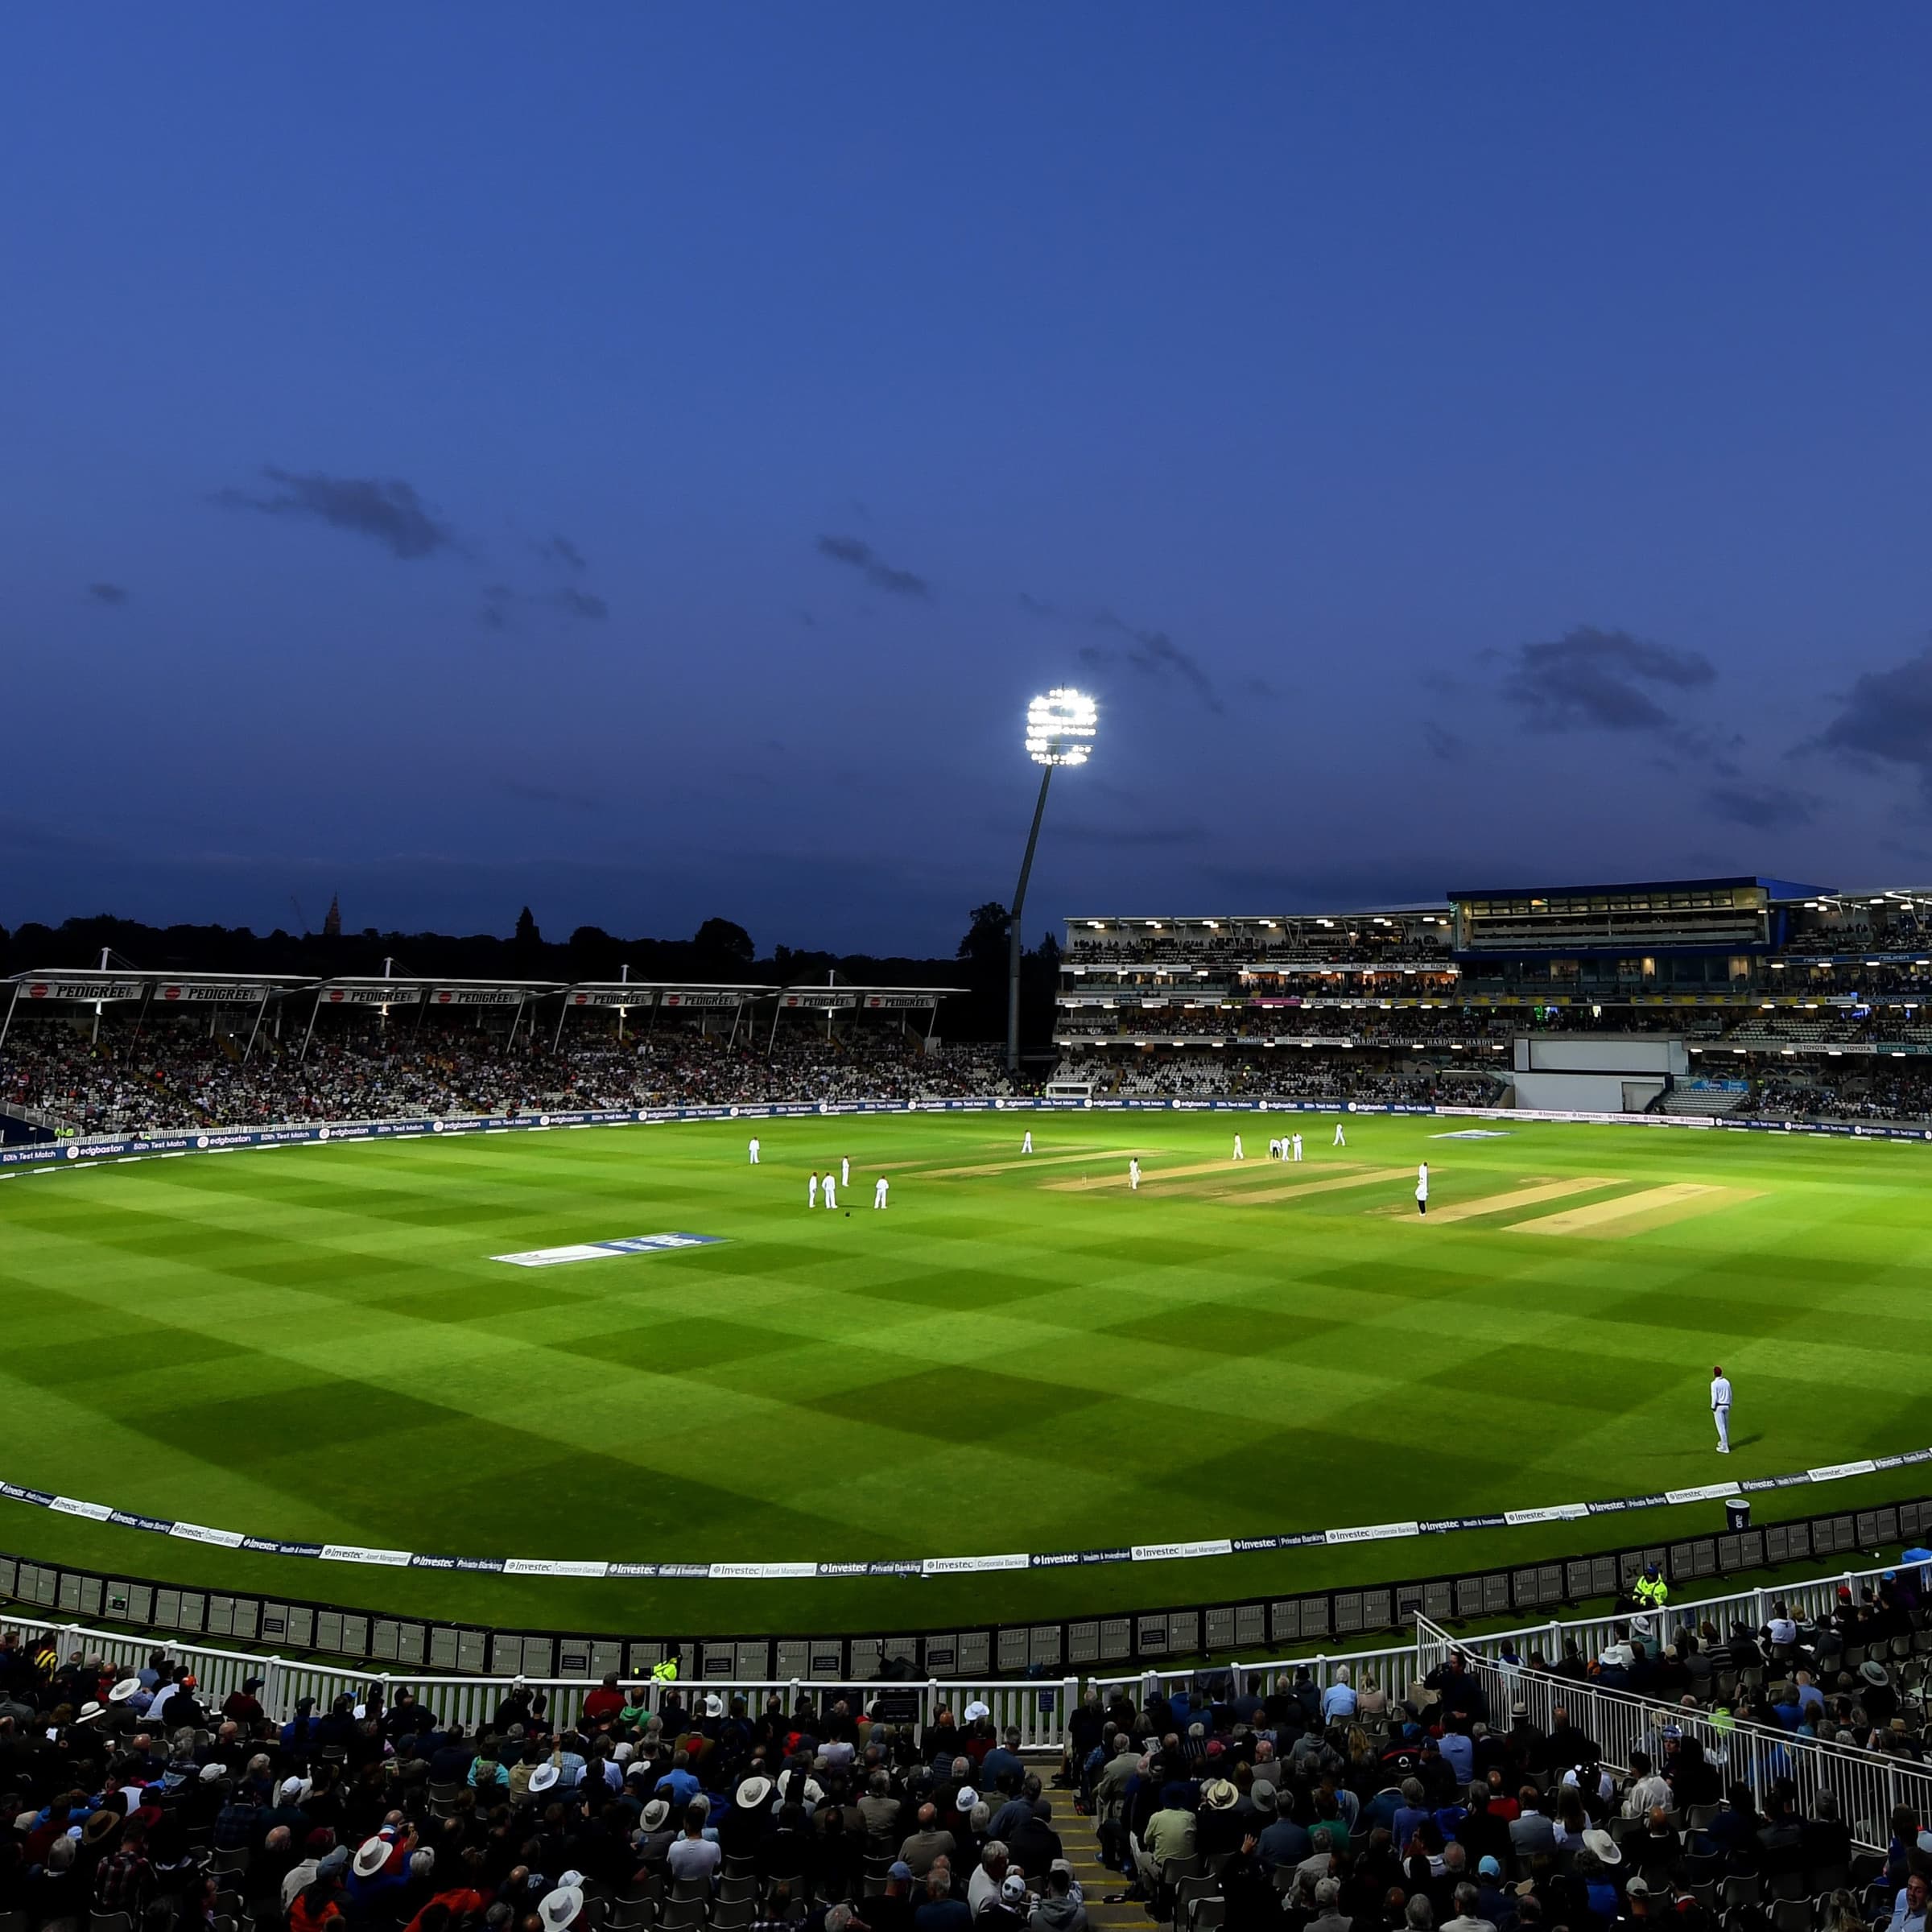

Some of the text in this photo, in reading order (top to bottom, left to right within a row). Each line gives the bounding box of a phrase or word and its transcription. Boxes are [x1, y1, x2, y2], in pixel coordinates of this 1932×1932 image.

[56, 985, 125, 998] PEDIGREE
[188, 989, 250, 1000] PEDIGREE
[351, 991, 408, 1001] PEDIGREE
[457, 993, 510, 1003] PEDIGREE
[593, 995, 642, 1005] PEDIGREE
[684, 996, 731, 1005] PEDIGREE
[803, 997, 848, 1006] PEDIGREE
[885, 998, 928, 1006] PEDIGREE
[551, 1115, 584, 1125] edgbaston
[407, 1123, 424, 1131] Match
[444, 1121, 481, 1130] edgbaston
[291, 1130, 310, 1138] Match
[331, 1127, 369, 1137] edgbaston
[209, 1135, 251, 1146] edgbaston
[80, 1145, 124, 1156] edgbaston
[3, 1150, 56, 1162] 50th Test Match
[1748, 1480, 1776, 1490] Investec
[1674, 1490, 1703, 1500] Investec
[1596, 1501, 1626, 1512] Investec
[1516, 1510, 1546, 1521] Investec
[1426, 1521, 1460, 1530] Investec
[179, 1525, 204, 1538] Investec
[1336, 1530, 1370, 1540] Investec
[1397, 1525, 1418, 1534] Banking
[248, 1538, 279, 1550] Investec
[1241, 1534, 1325, 1550] Investec Private Banking
[331, 1548, 364, 1559] Investec
[1143, 1546, 1179, 1557] Investec
[1198, 1544, 1230, 1554] Management
[419, 1556, 503, 1572] Investec Private Banking
[1041, 1554, 1079, 1565] Investec
[515, 1562, 552, 1571] Investec
[617, 1564, 656, 1574] Investec
[828, 1563, 921, 1573] Investec Private Banking
[935, 1561, 973, 1570] Investec
[977, 1560, 1004, 1569] Corporate
[721, 1566, 760, 1575] Investec
